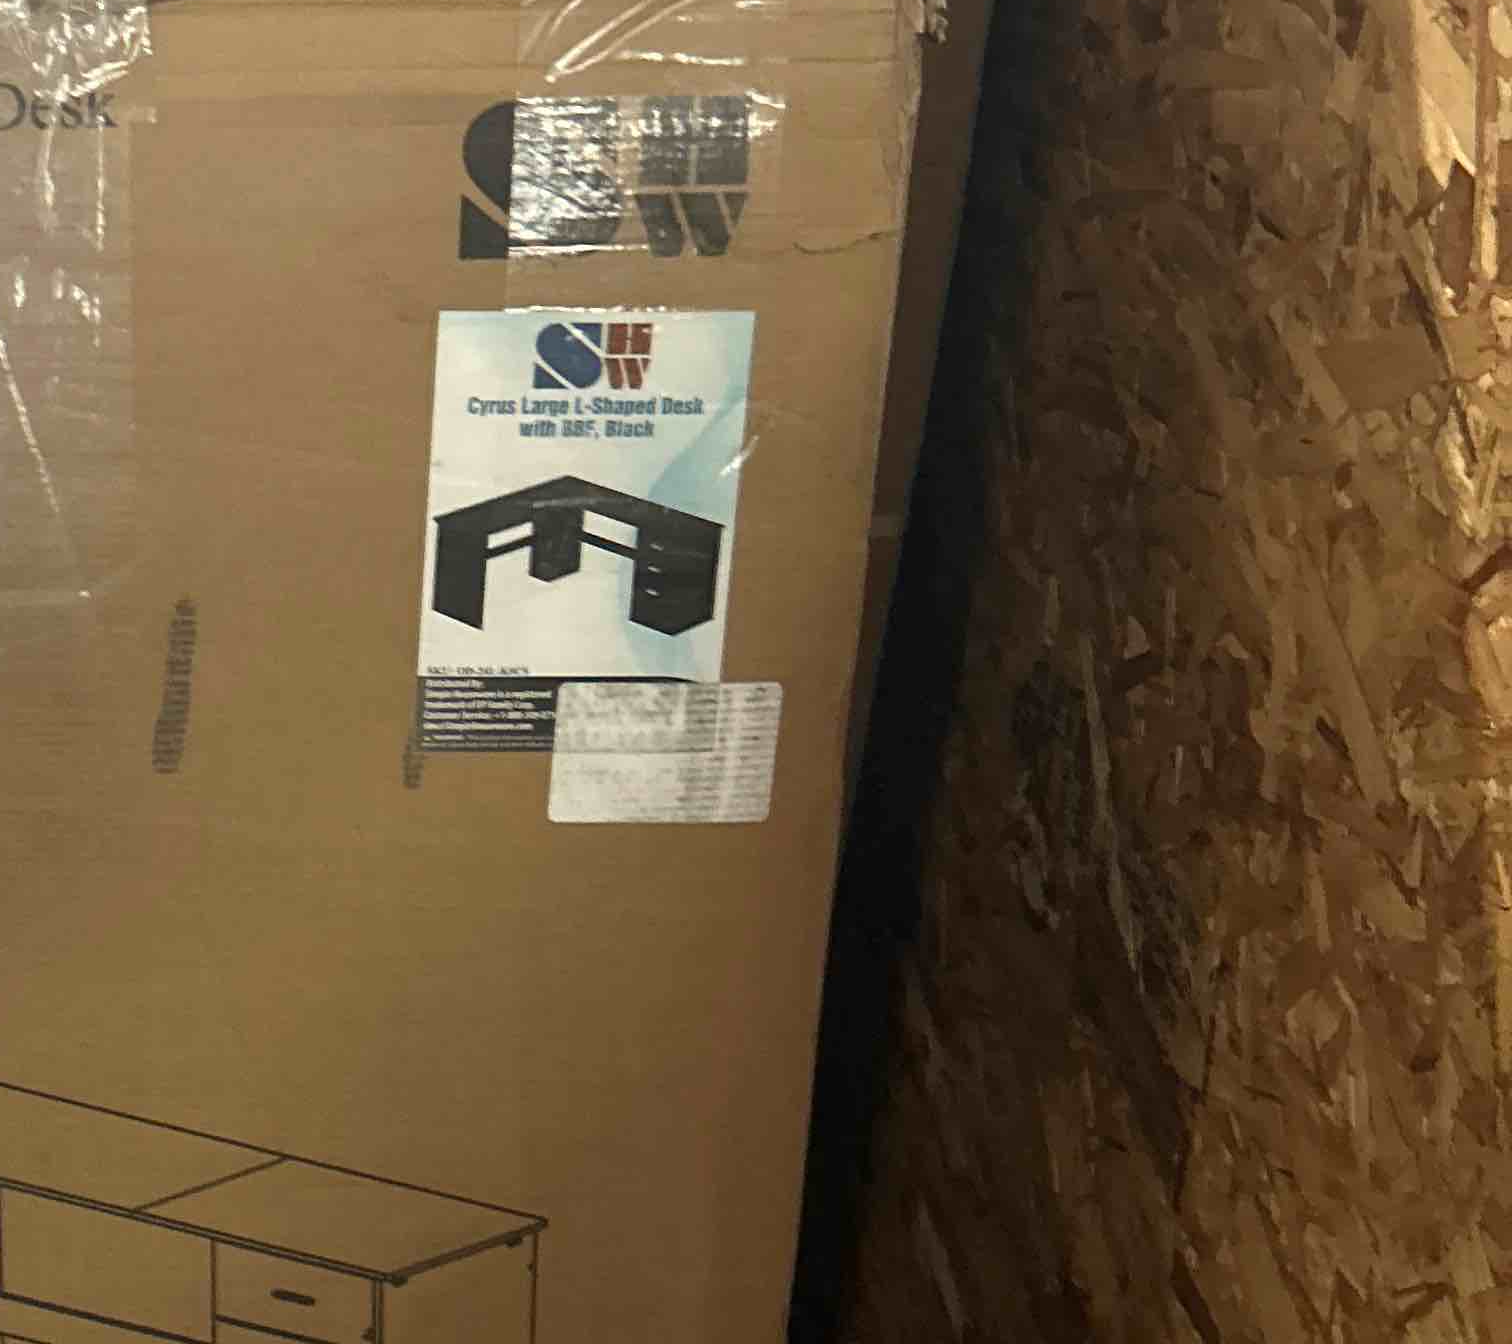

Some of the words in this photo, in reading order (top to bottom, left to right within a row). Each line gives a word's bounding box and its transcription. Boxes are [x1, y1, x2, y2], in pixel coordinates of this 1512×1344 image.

[467, 397, 516, 417] Cyrus
[521, 397, 569, 416] Large
[575, 396, 656, 417] L-Shaped
[660, 396, 704, 416] Desk
[520, 420, 556, 438] with
[605, 420, 654, 438] Black
